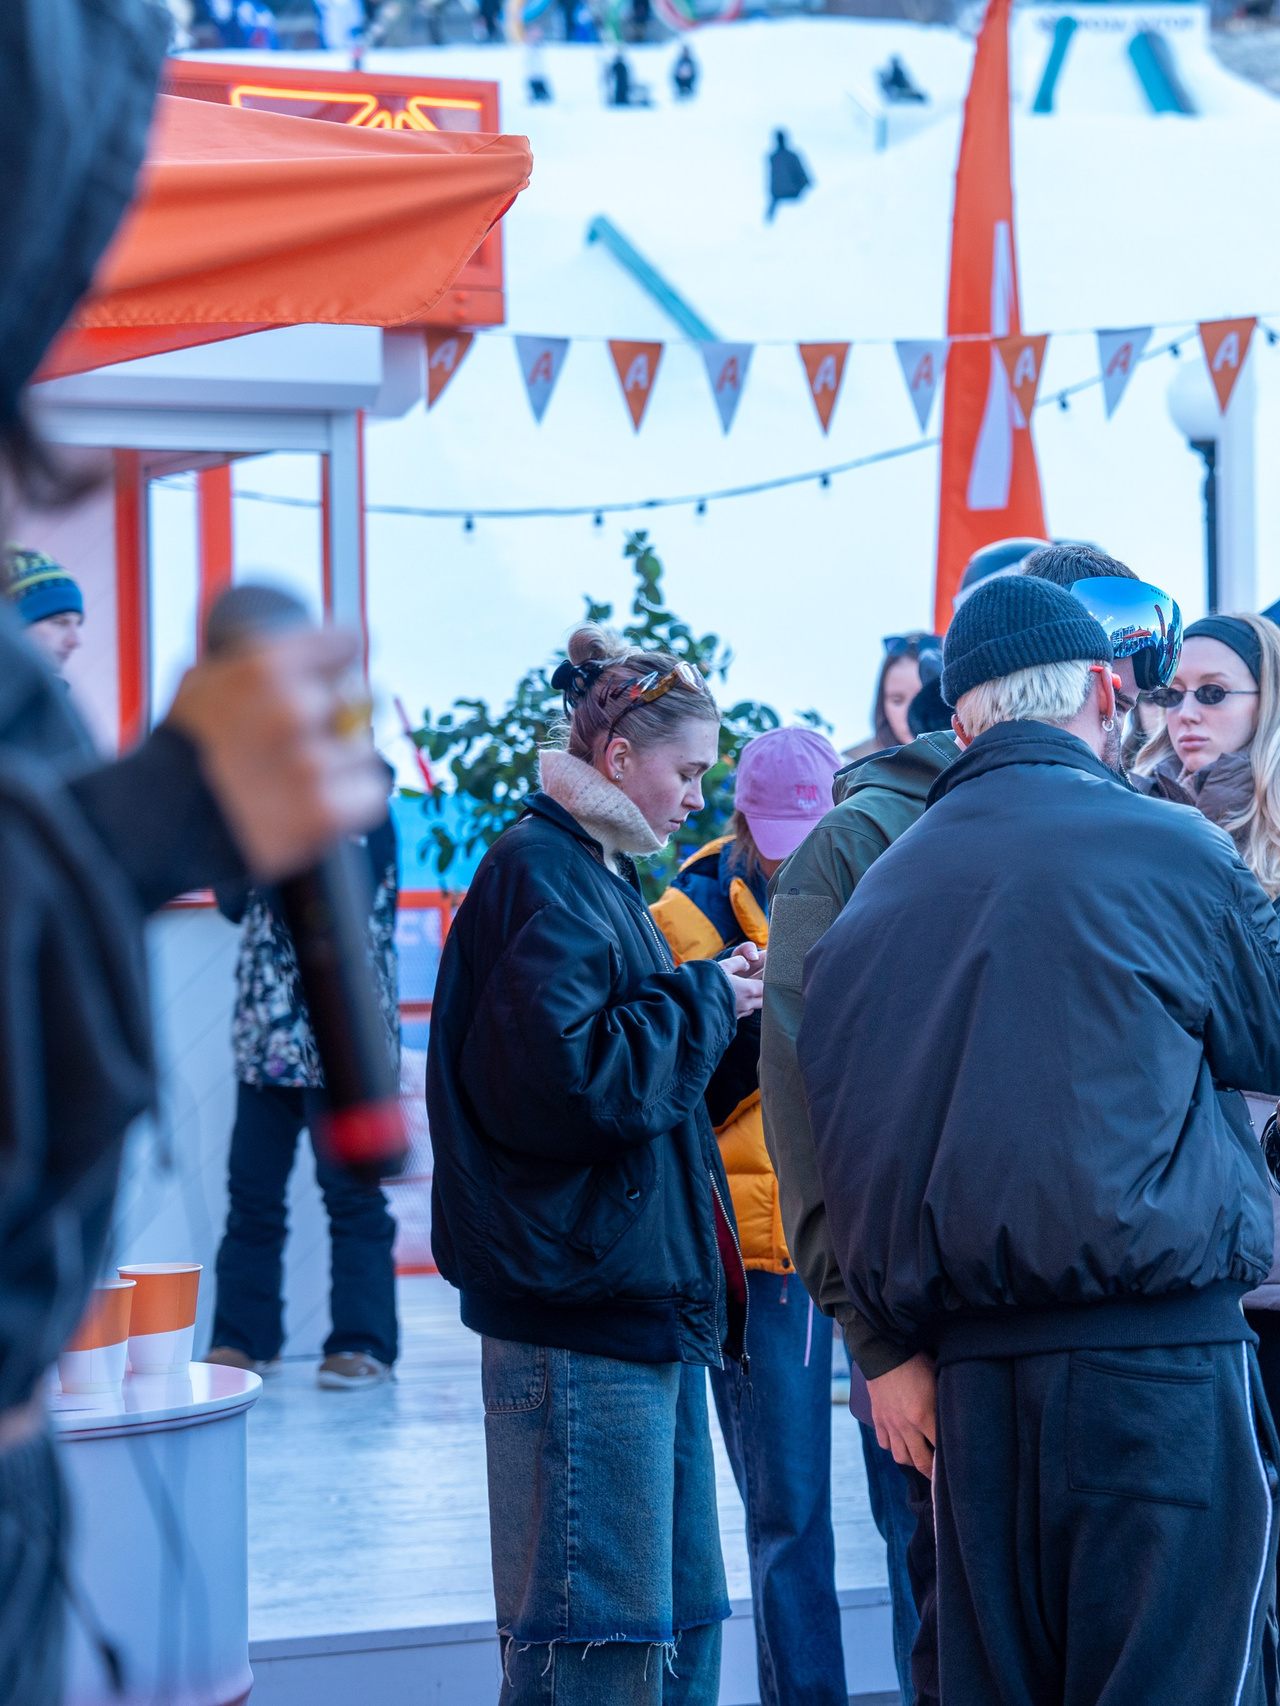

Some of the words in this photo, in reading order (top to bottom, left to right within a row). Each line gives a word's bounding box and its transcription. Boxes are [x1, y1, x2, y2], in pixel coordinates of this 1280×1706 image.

[430, 338, 458, 371] A
[529, 350, 553, 386] A
[1013, 345, 1037, 388] A
[1106, 341, 1133, 378] A
[1212, 331, 1239, 372] A
[624, 353, 649, 392] A
[716, 355, 739, 394] A
[813, 354, 837, 395] A
[912, 352, 933, 391] A
